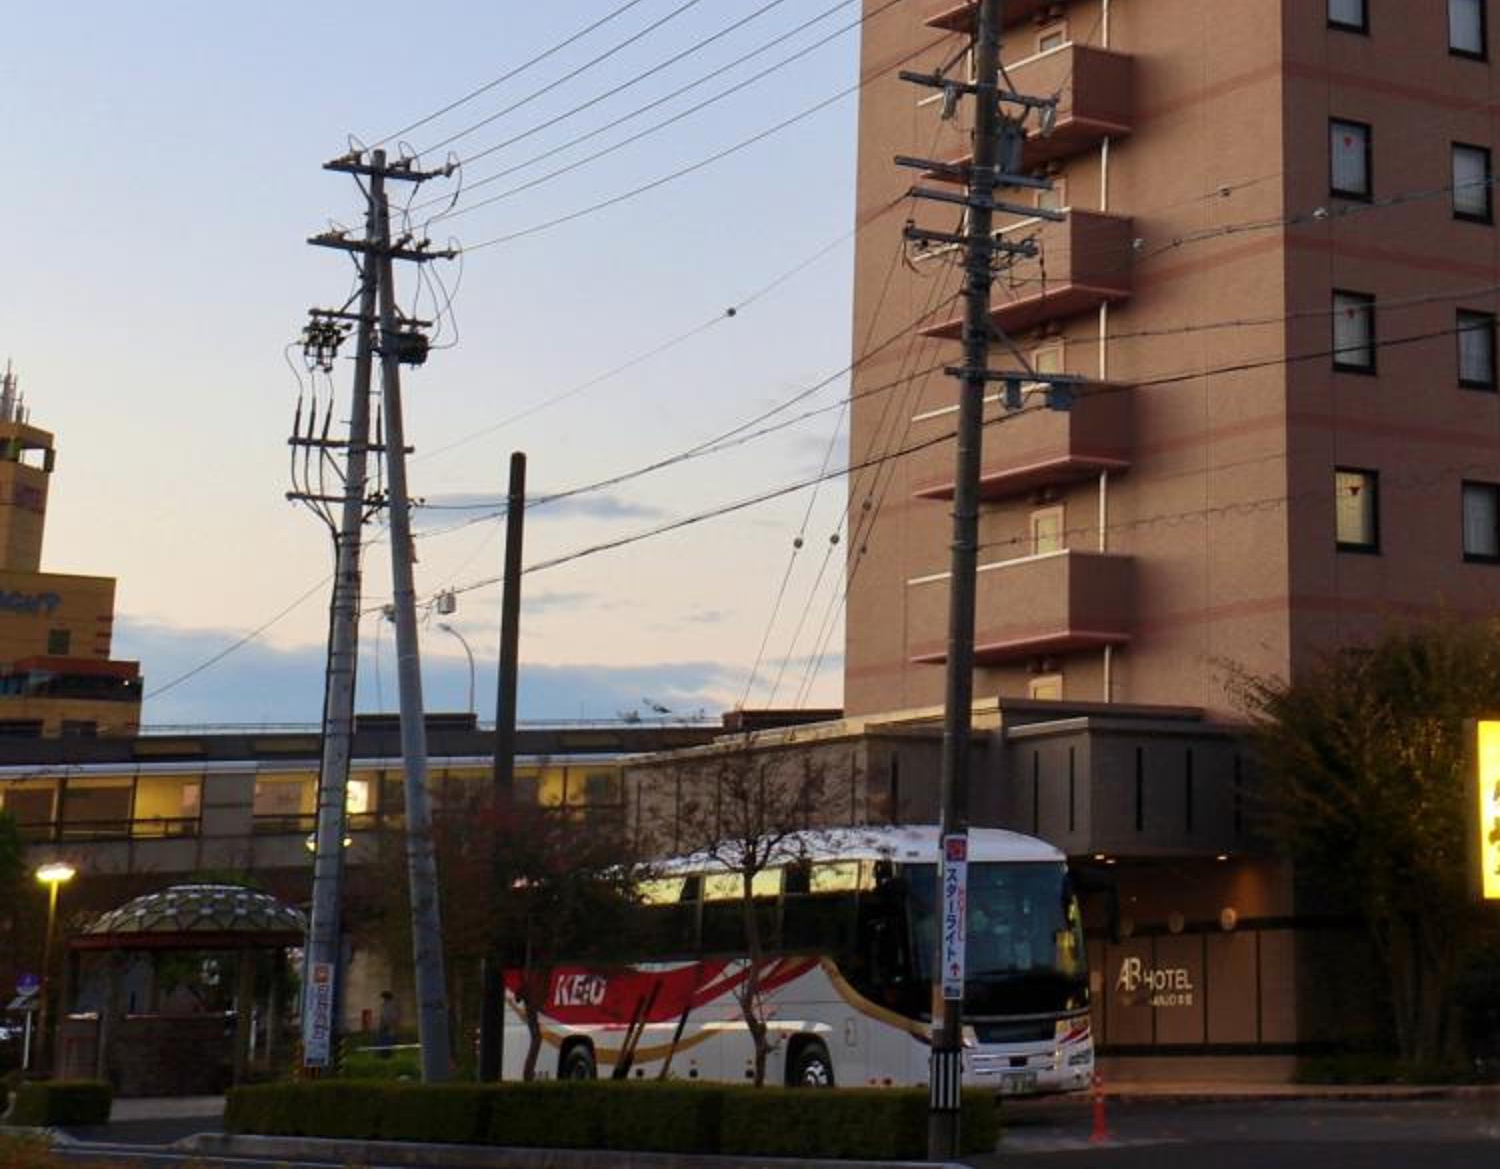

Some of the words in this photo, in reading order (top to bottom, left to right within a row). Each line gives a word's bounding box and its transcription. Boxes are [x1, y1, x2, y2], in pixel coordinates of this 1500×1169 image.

[946, 868, 958, 962] スターライト
[1115, 957, 1141, 991] AB
[1143, 969, 1193, 991] HOTEL
